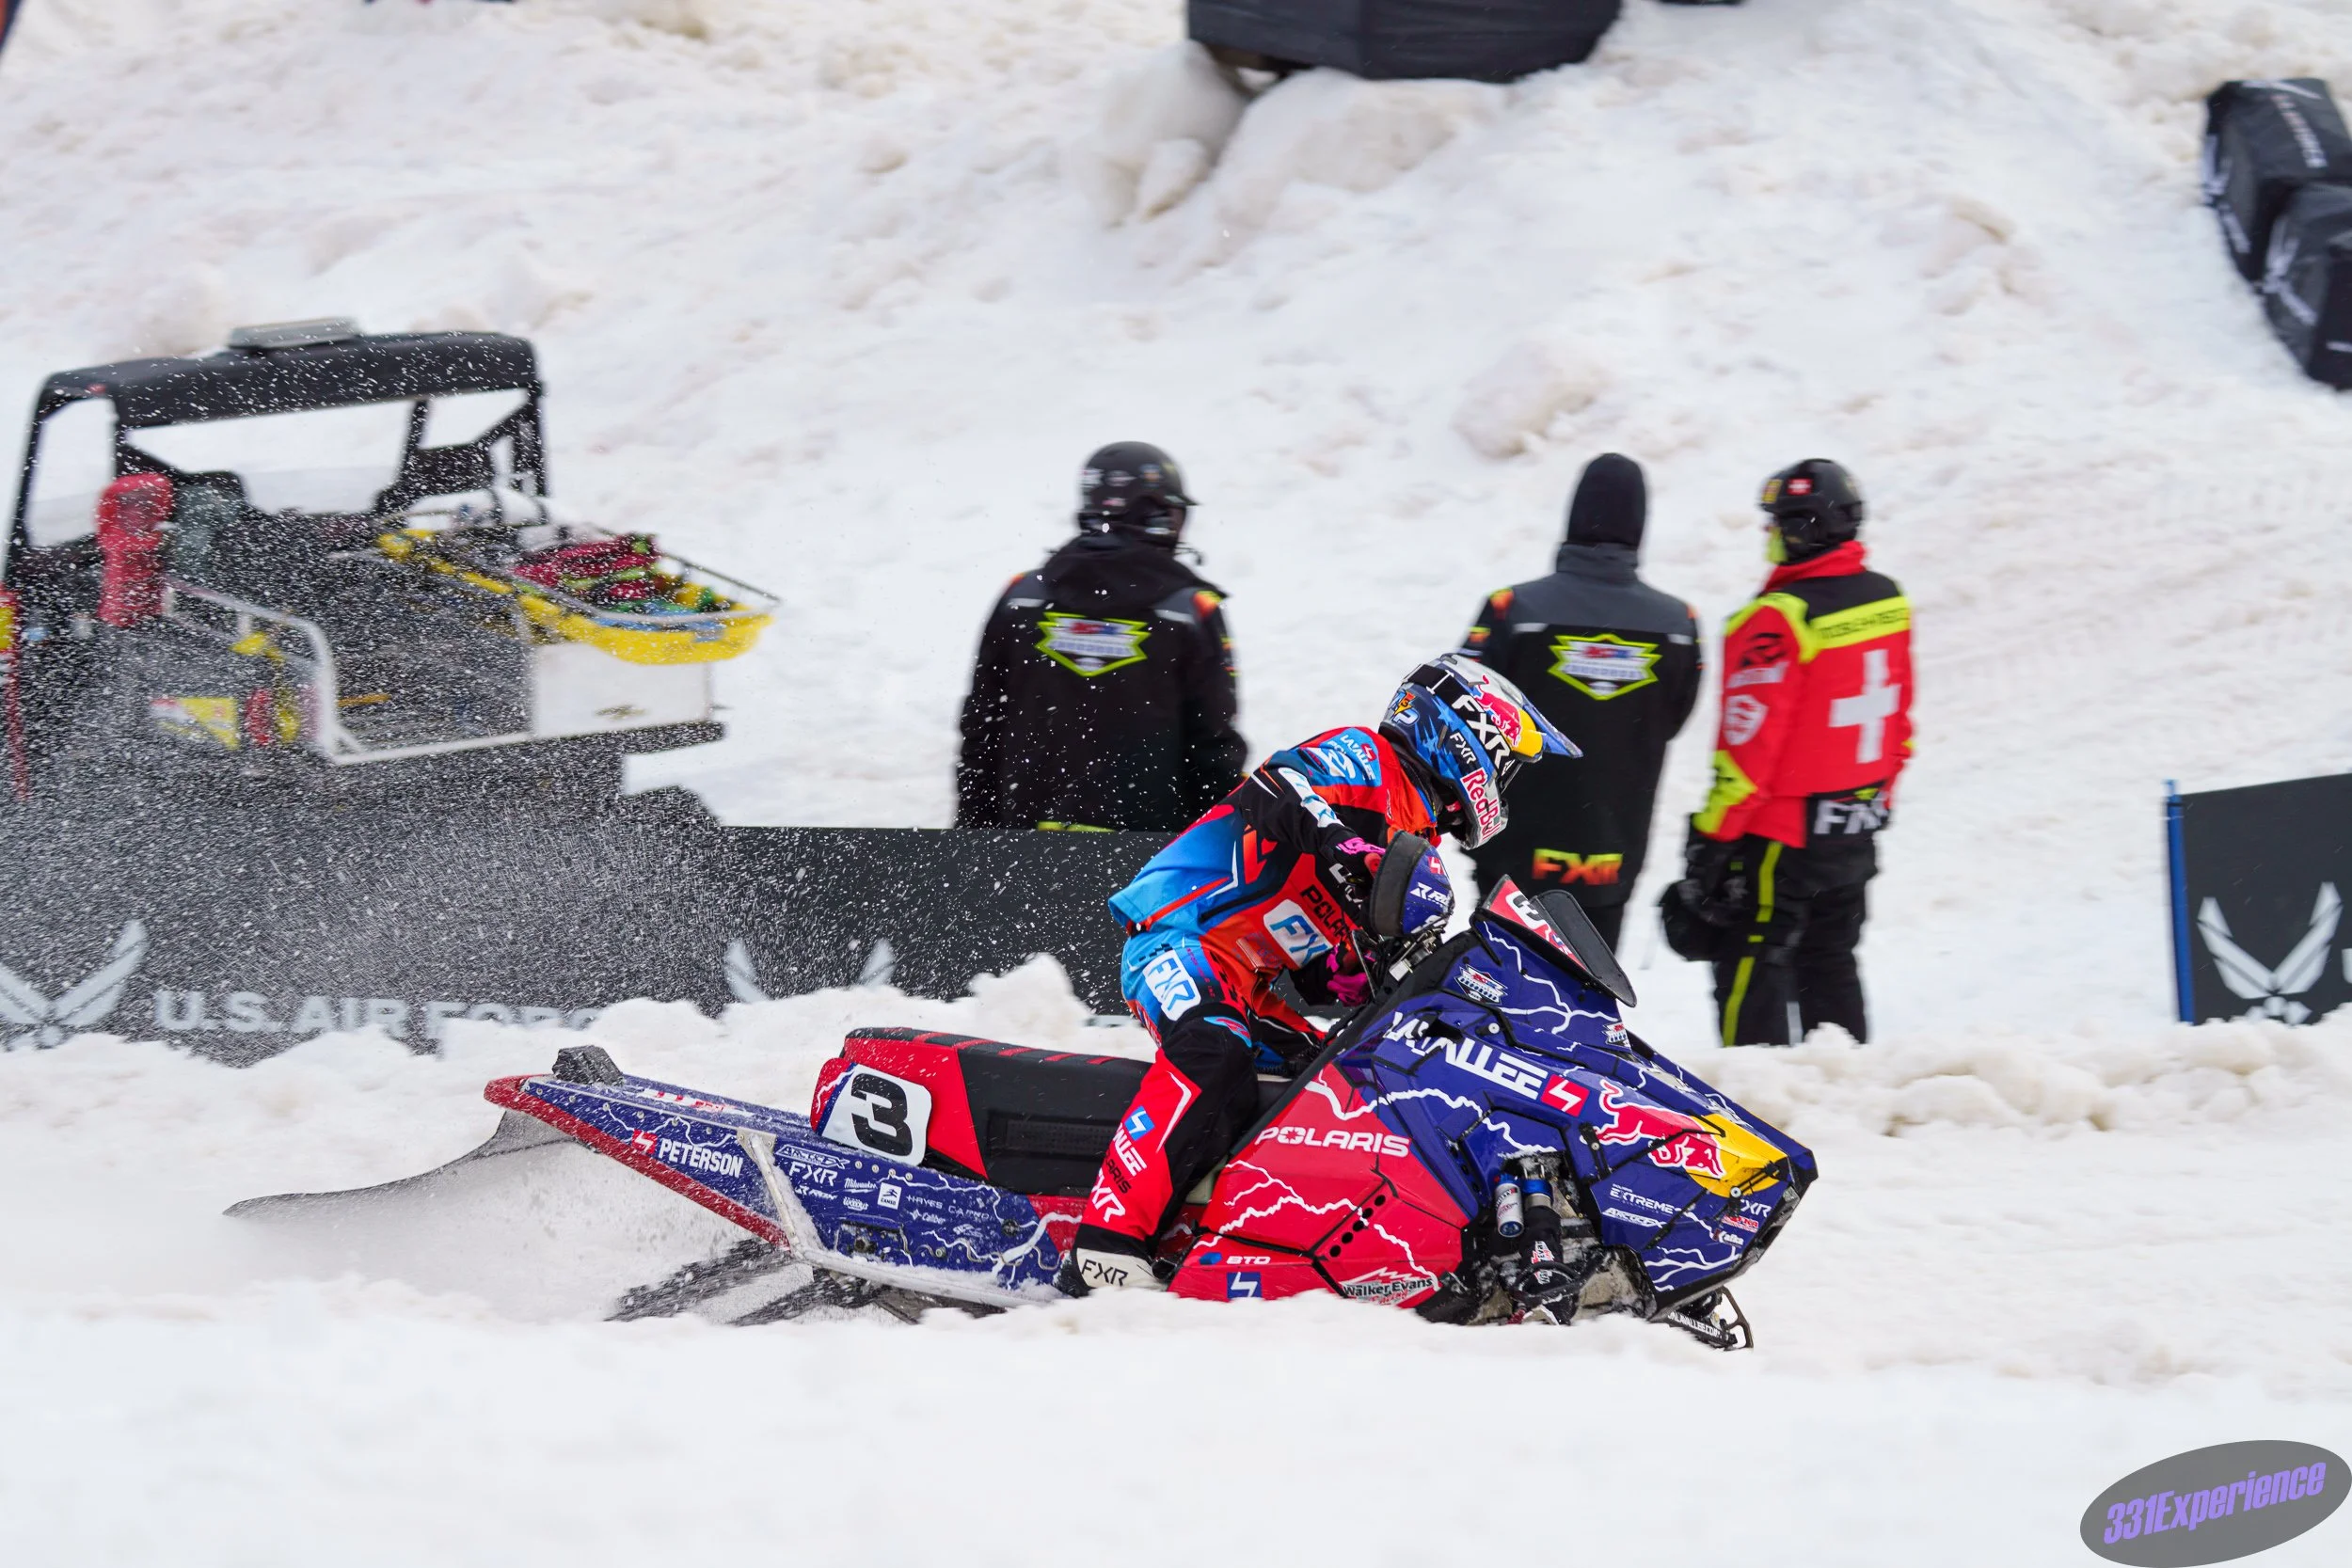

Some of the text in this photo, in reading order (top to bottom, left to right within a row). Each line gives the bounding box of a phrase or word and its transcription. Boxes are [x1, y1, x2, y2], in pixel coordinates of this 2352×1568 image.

[1452, 694, 1511, 769] FXR
[1450, 732, 1477, 764] FXR
[1532, 847, 1624, 885] FXR
[1269, 913, 1329, 967] FX
[1147, 958, 1197, 1011] FXR
[850, 1073, 914, 1156] 3
[658, 1137, 743, 1178] PETERSON
[1254, 1126, 1410, 1158] POLARIS
[789, 1161, 838, 1187] FXR
[1610, 1187, 1674, 1214] EXTREME
[1739, 1198, 1772, 1218] XR
[1082, 1259, 1128, 1287] FXR
[1391, 1277, 1433, 1292] Evans
